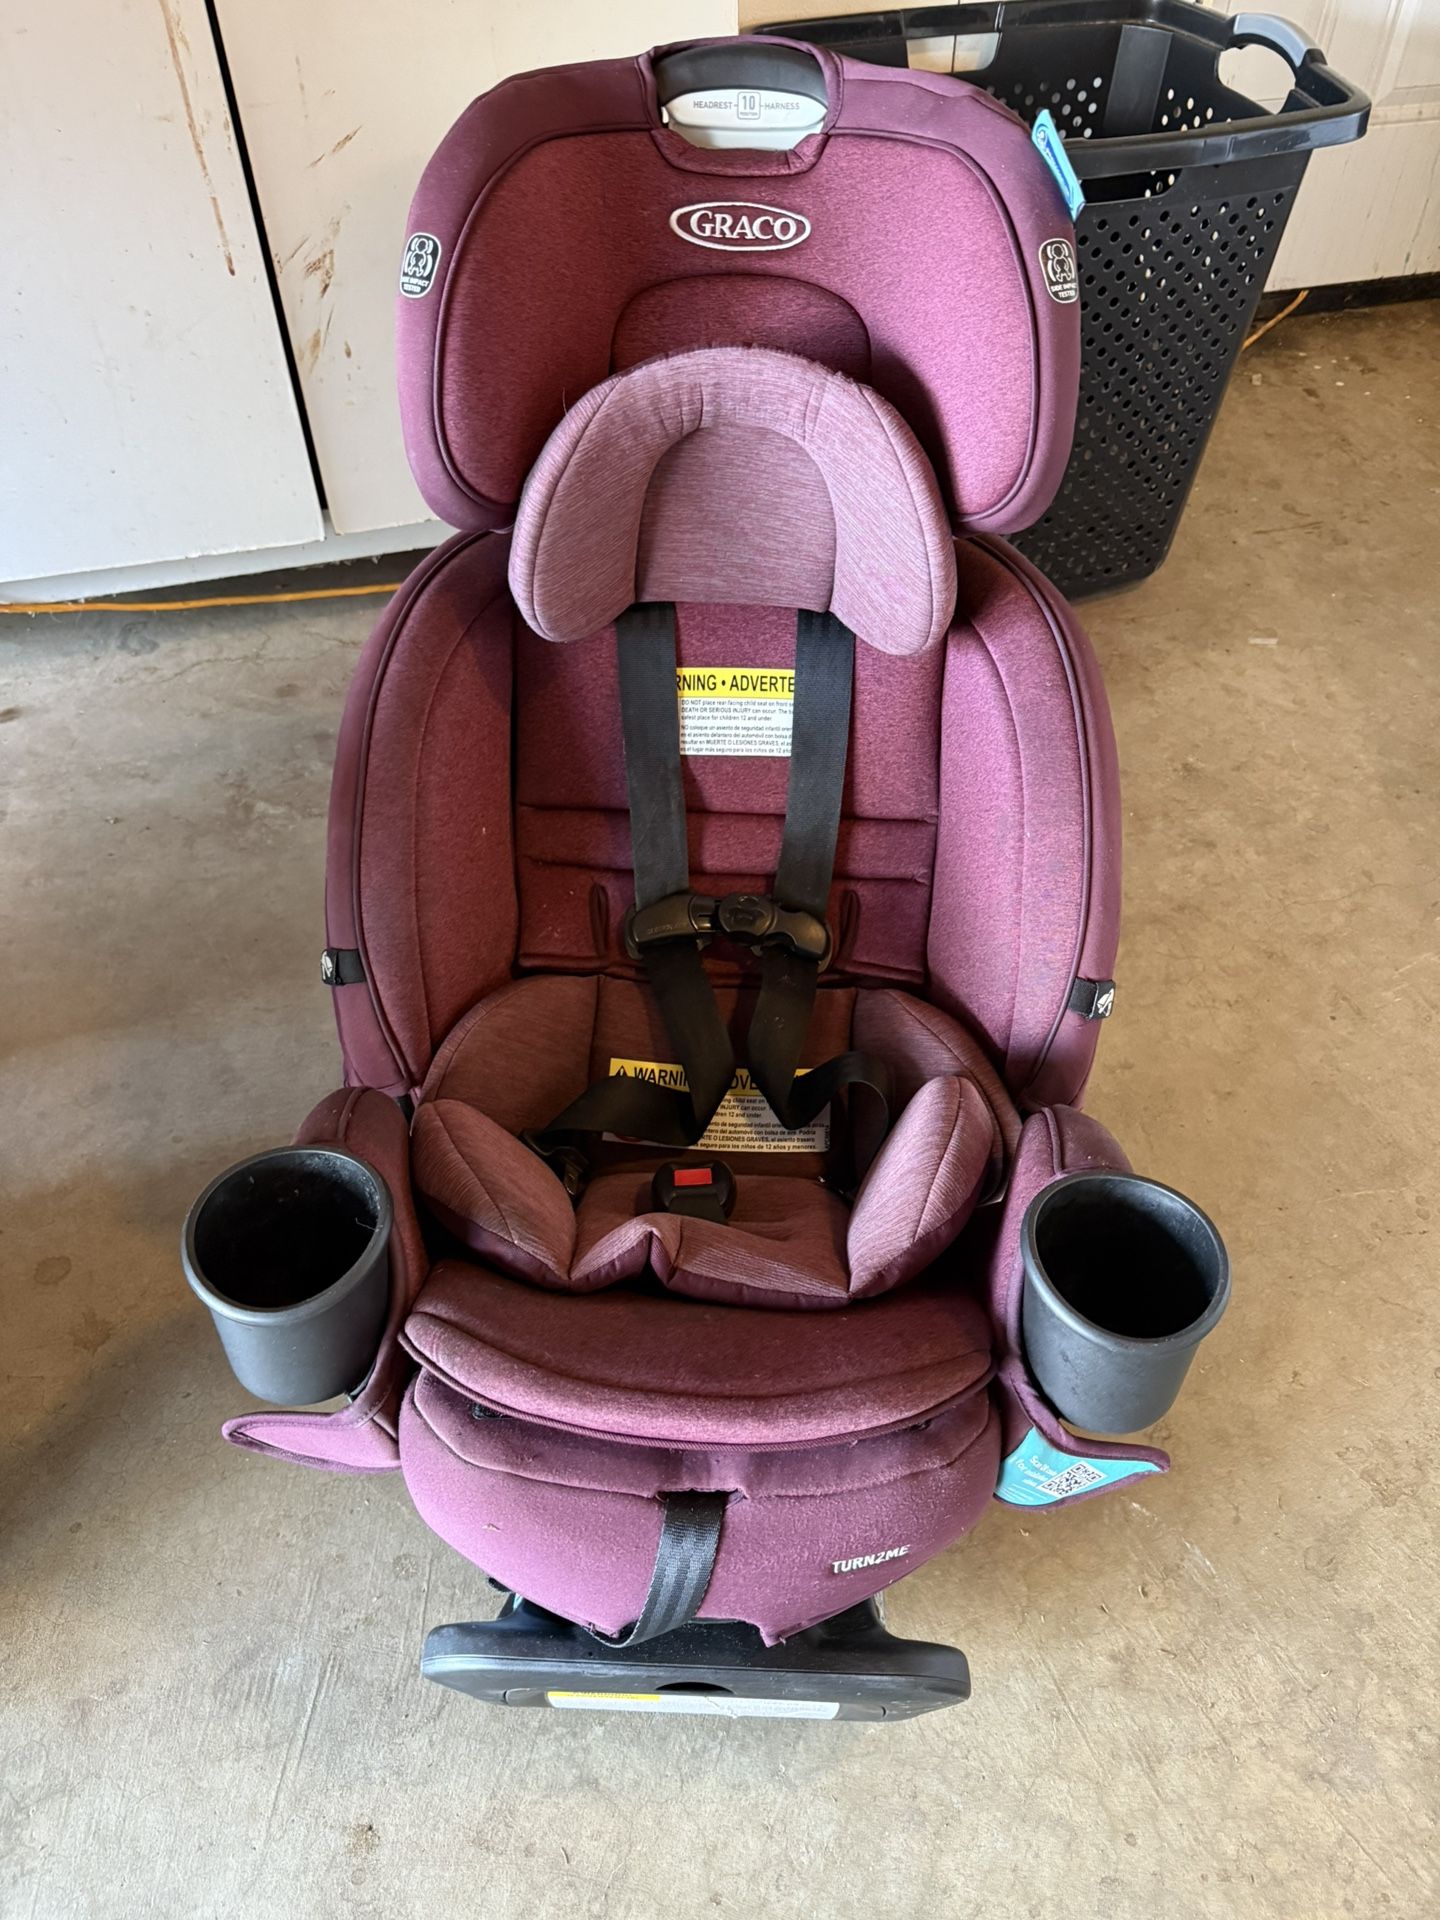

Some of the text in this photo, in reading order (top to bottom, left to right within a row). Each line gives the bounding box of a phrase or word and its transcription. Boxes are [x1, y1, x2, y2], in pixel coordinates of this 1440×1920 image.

[693, 101, 732, 109] HEADREST
[742, 95, 756, 110] 10
[764, 102, 800, 110] HARNESS
[690, 210, 797, 241] GRACO
[634, 1067, 687, 1086] WARNI
[832, 1544, 911, 1573] TURN2ME
